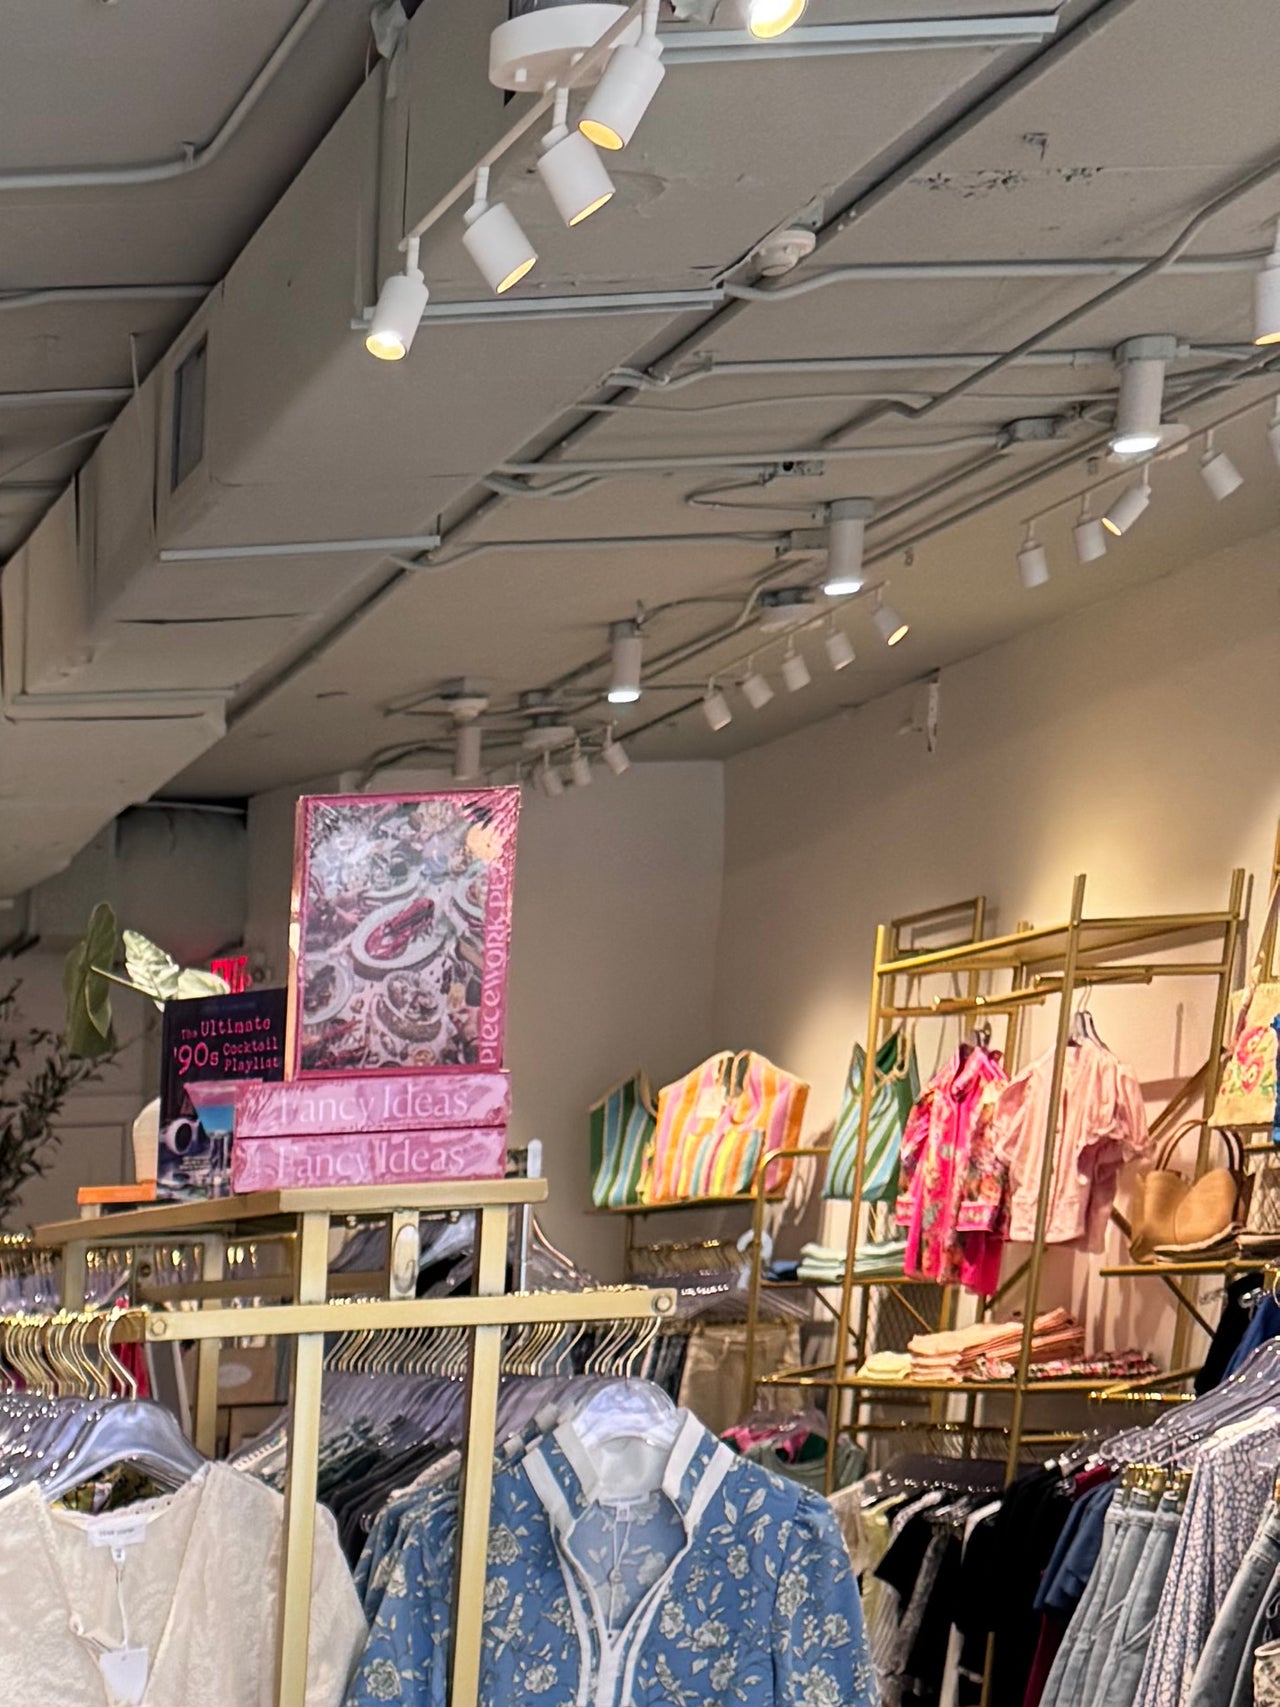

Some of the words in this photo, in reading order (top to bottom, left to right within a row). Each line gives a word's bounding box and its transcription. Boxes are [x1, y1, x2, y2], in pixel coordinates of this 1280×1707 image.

[200, 1017, 271, 1037] Ultimate
[222, 1036, 278, 1056] Cocktail
[223, 1056, 279, 1074] Playlist
[279, 1089, 375, 1127] Fancy
[383, 1082, 469, 1120] Ideas
[277, 1145, 370, 1181] Fancy
[379, 1138, 466, 1175] Ideas
